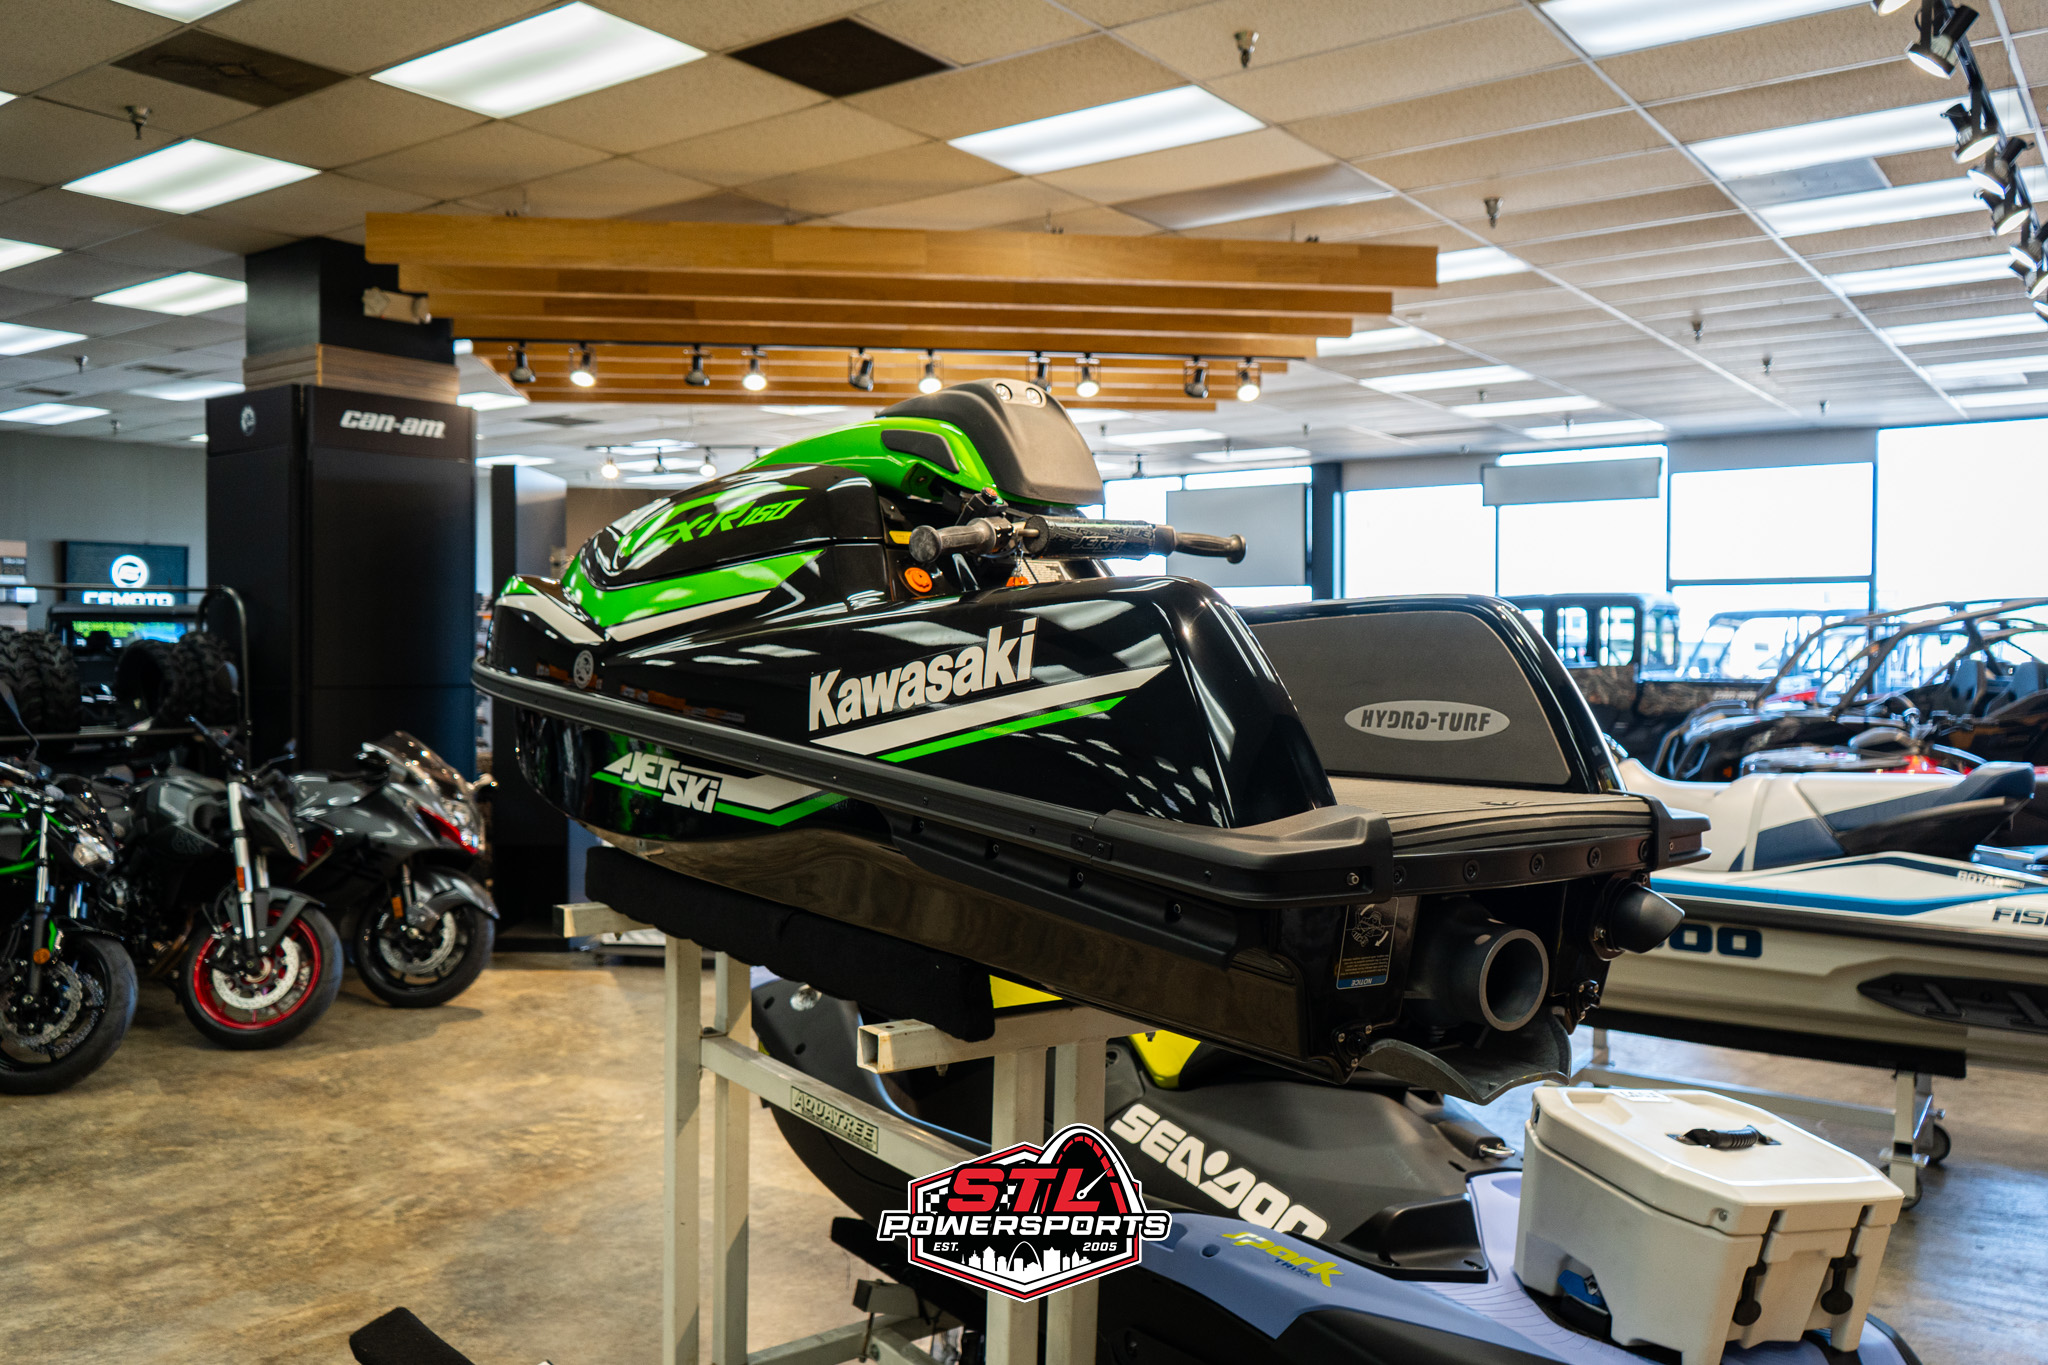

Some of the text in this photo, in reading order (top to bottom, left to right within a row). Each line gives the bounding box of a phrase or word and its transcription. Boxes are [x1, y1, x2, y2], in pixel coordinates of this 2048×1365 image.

[340, 409, 446, 439] can-am
[735, 498, 806, 529] 160
[808, 617, 1038, 731] Kawasaki
[1360, 709, 1491, 732] HYDRO-TURF
[1992, 906, 2048, 927] FIS
[1654, 923, 1763, 959] 00
[794, 1090, 875, 1143] AQUATREE
[1274, 1257, 1313, 1279] TRIXX
